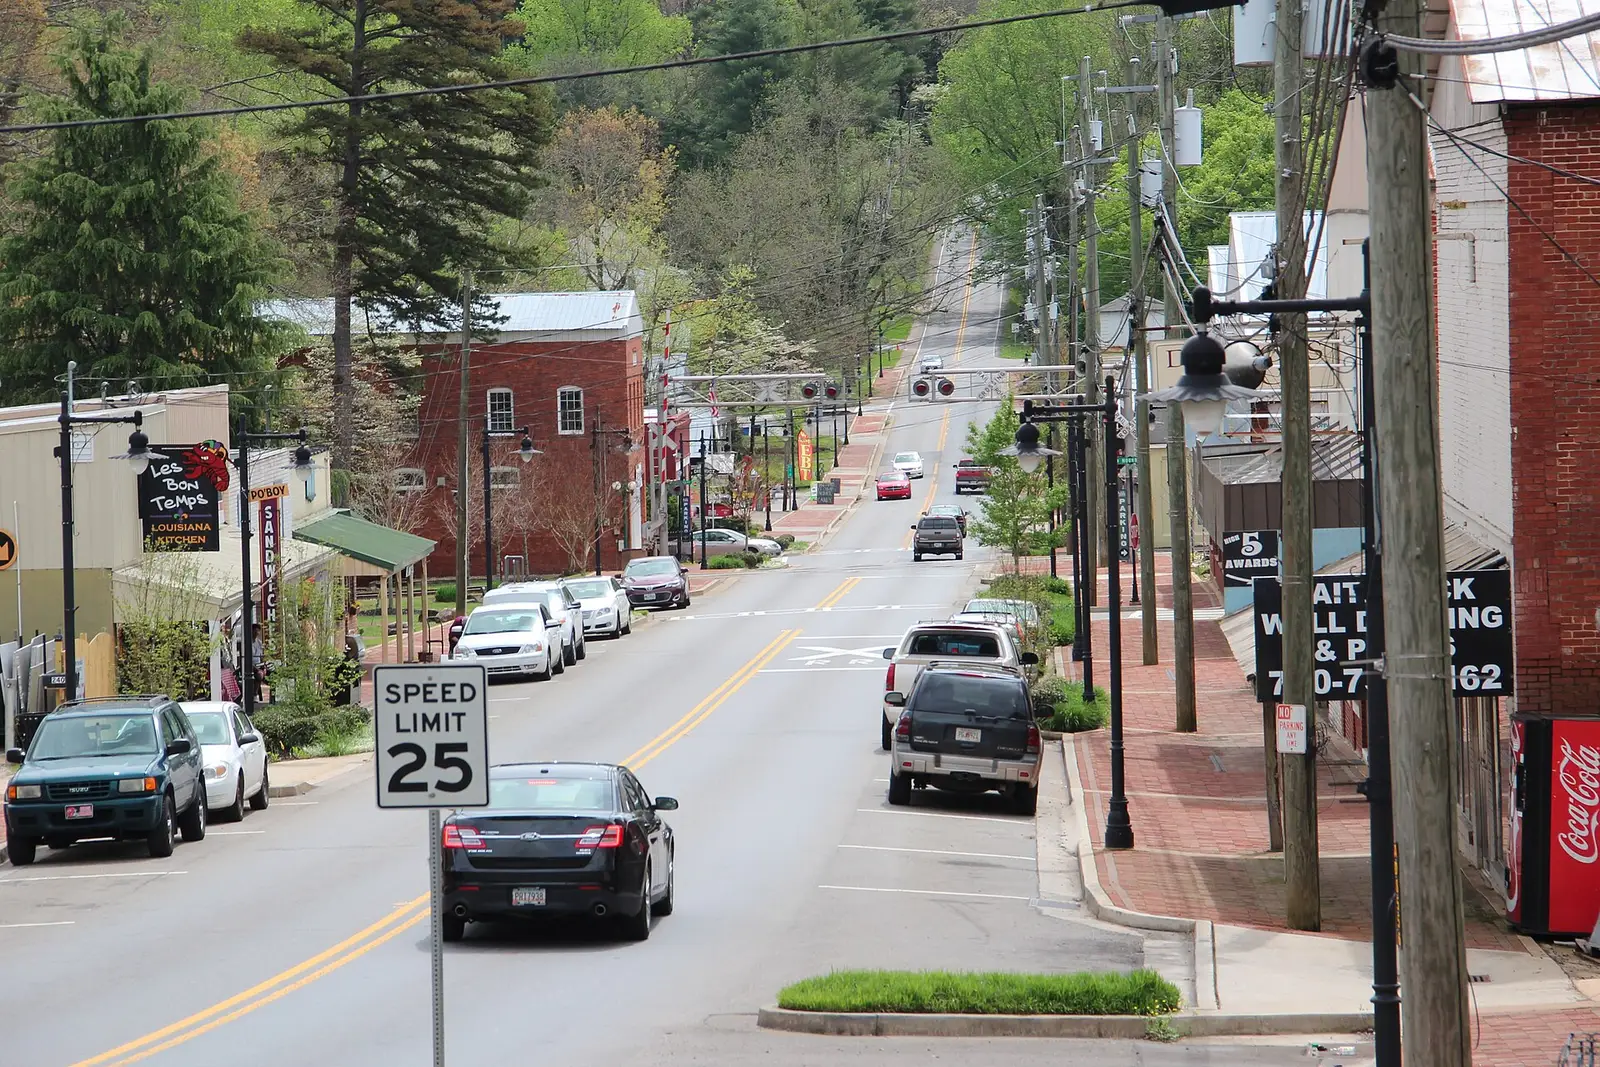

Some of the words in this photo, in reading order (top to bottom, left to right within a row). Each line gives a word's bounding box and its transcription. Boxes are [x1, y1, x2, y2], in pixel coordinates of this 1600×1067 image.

[251, 485, 285, 500] PO'BOY
[151, 523, 211, 532] LOUISIANA
[1119, 498, 1127, 547] PARKING
[157, 535, 206, 544] KITCHEN
[1240, 531, 1263, 557] 5
[1225, 557, 1278, 569] AWARDS
[385, 682, 477, 704] SPEED
[1279, 706, 1290, 718] NO
[396, 712, 466, 733] LIMIT
[1279, 721, 1304, 731] PARKING
[387, 742, 473, 793] 25
[1558, 736, 1600, 864] Coca-Cola
